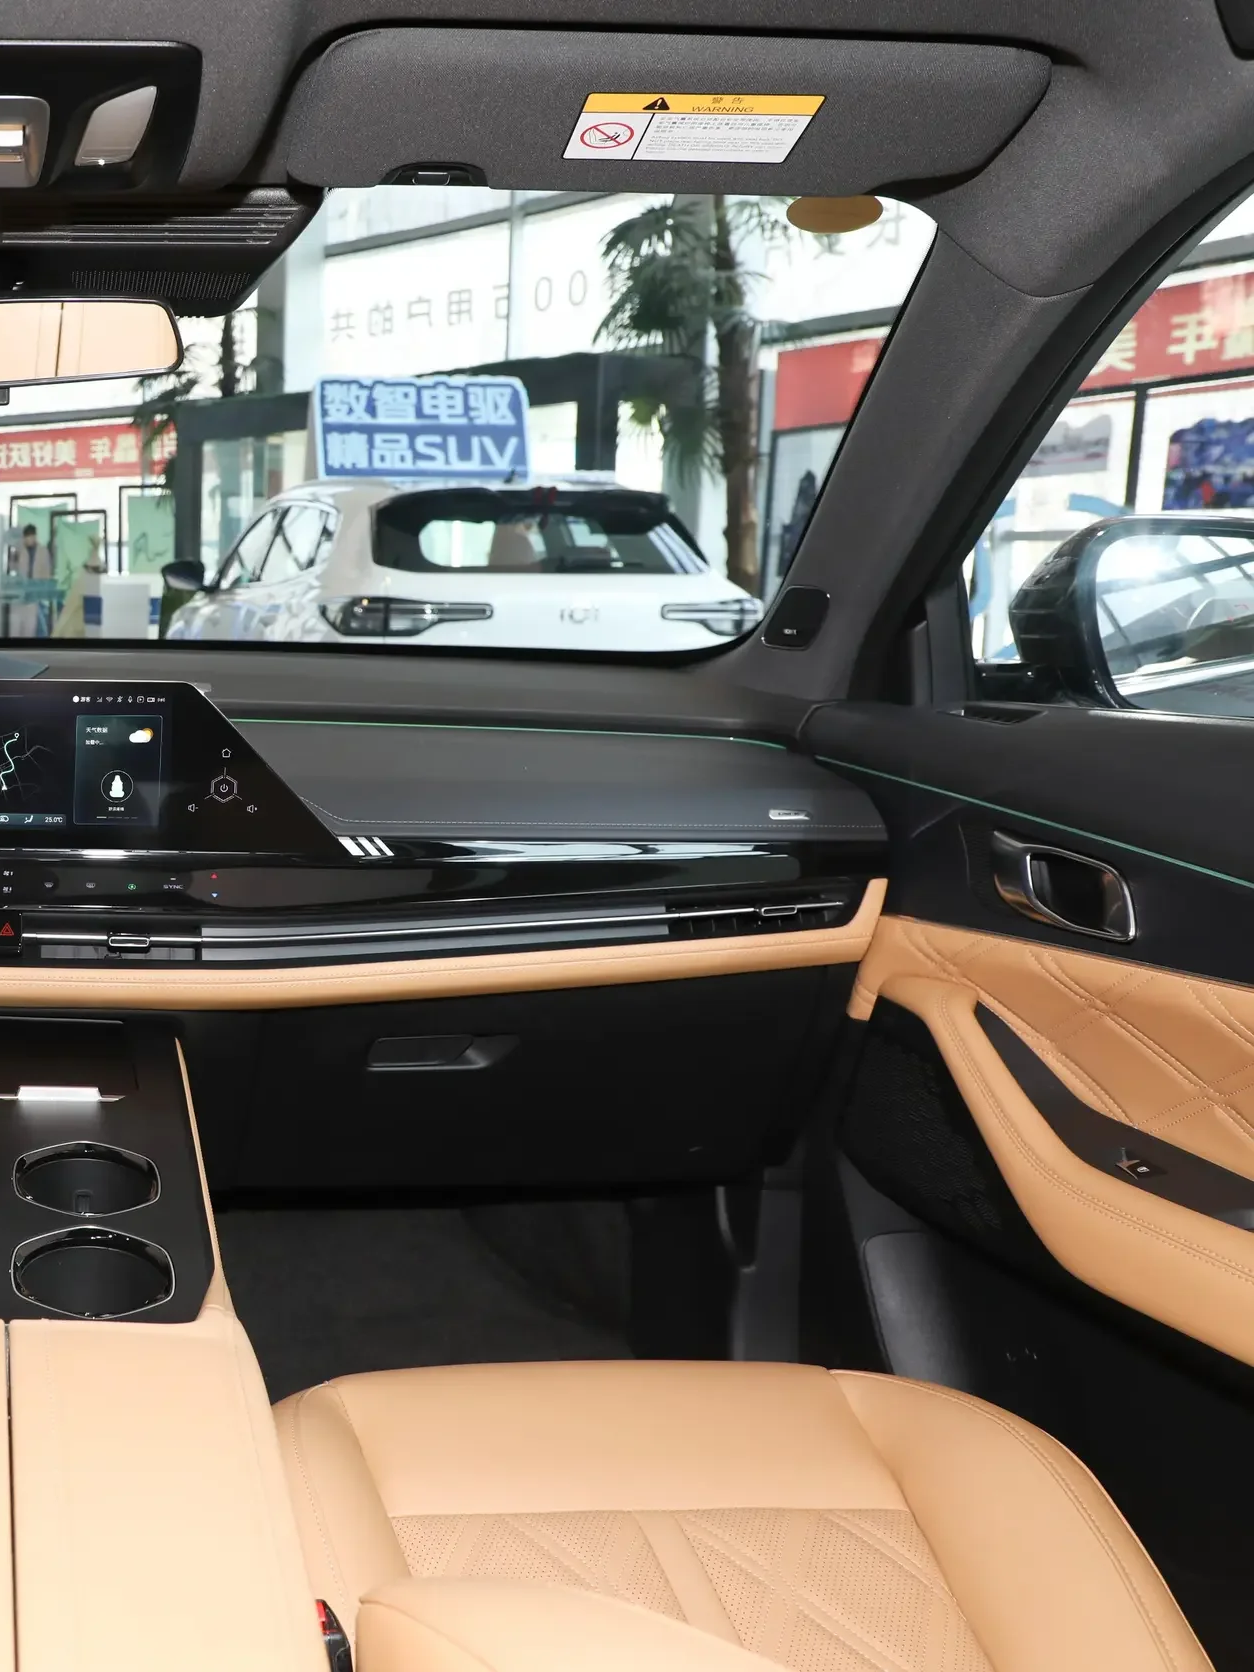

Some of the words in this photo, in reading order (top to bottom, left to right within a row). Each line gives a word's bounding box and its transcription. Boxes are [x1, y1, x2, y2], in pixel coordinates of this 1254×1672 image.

[323, 380, 516, 426] 数智电驱
[325, 432, 518, 471] 精品SUV
